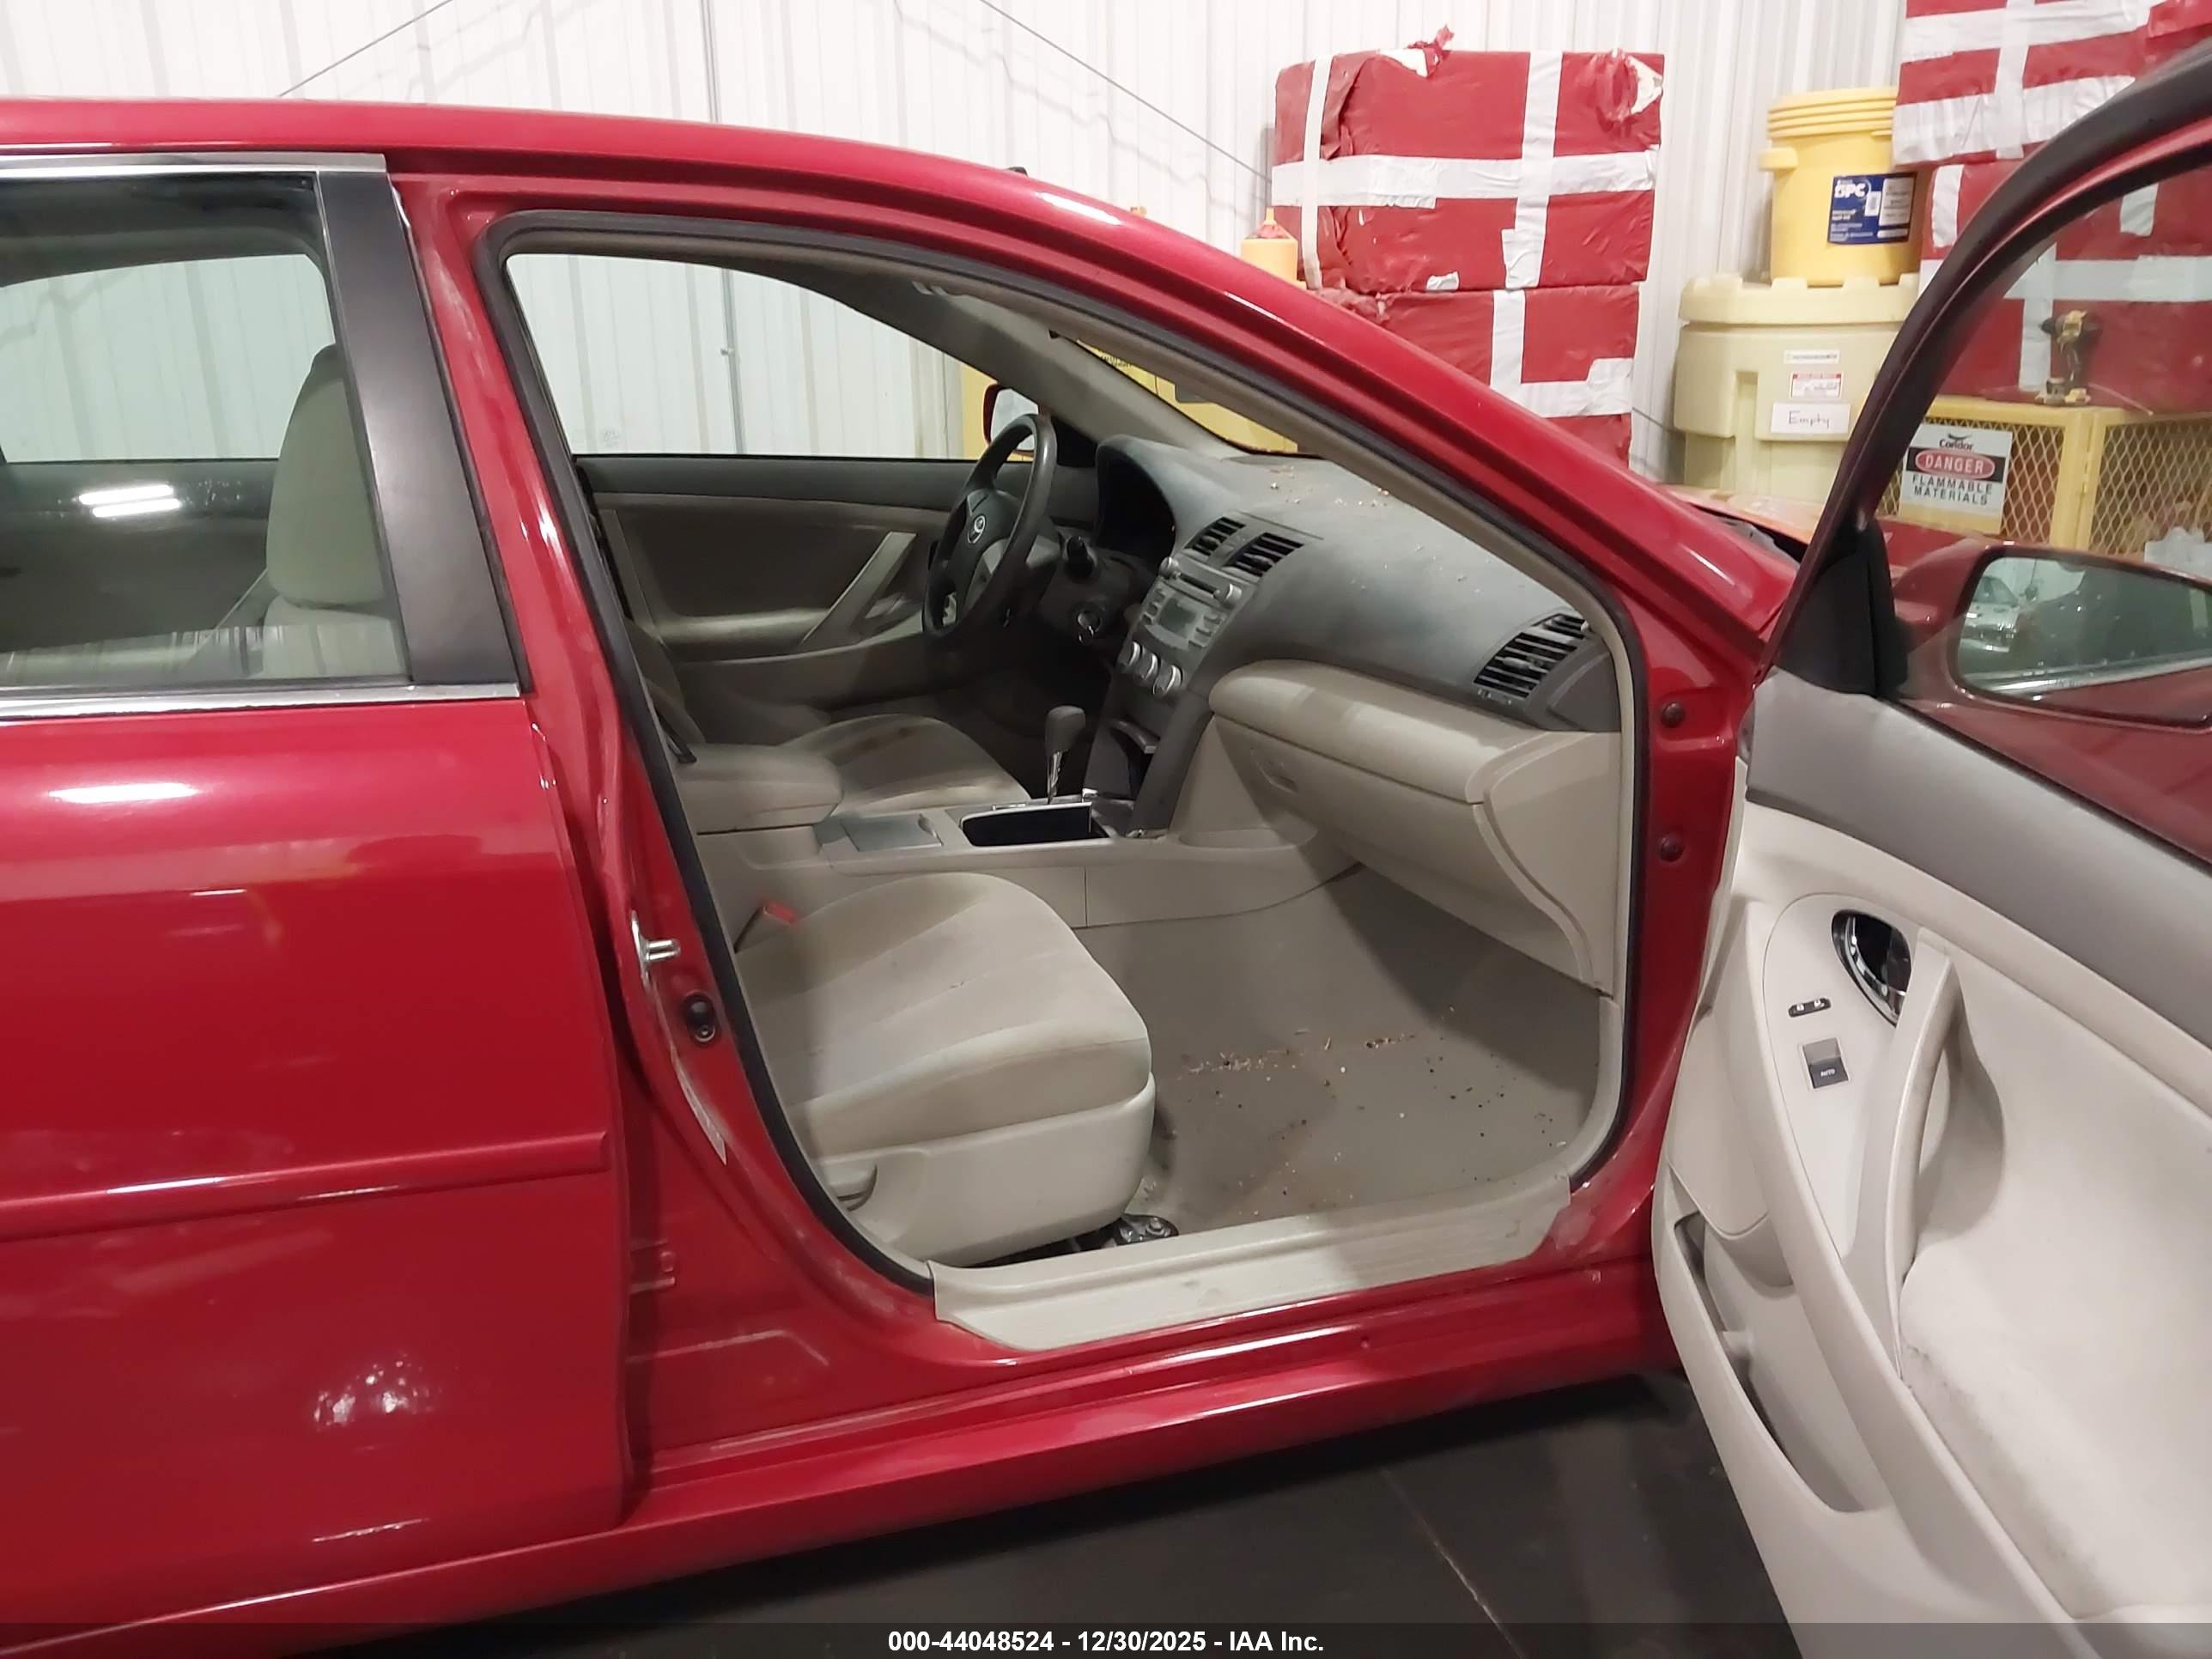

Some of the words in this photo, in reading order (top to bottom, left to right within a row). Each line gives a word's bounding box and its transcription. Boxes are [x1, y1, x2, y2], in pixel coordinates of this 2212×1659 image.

[1789, 410, 1830, 429] Empty
[1925, 454, 1984, 474] DANGER
[1912, 474, 1993, 495] FLAMMABLE
[1914, 485, 1988, 506] MATERIALS
